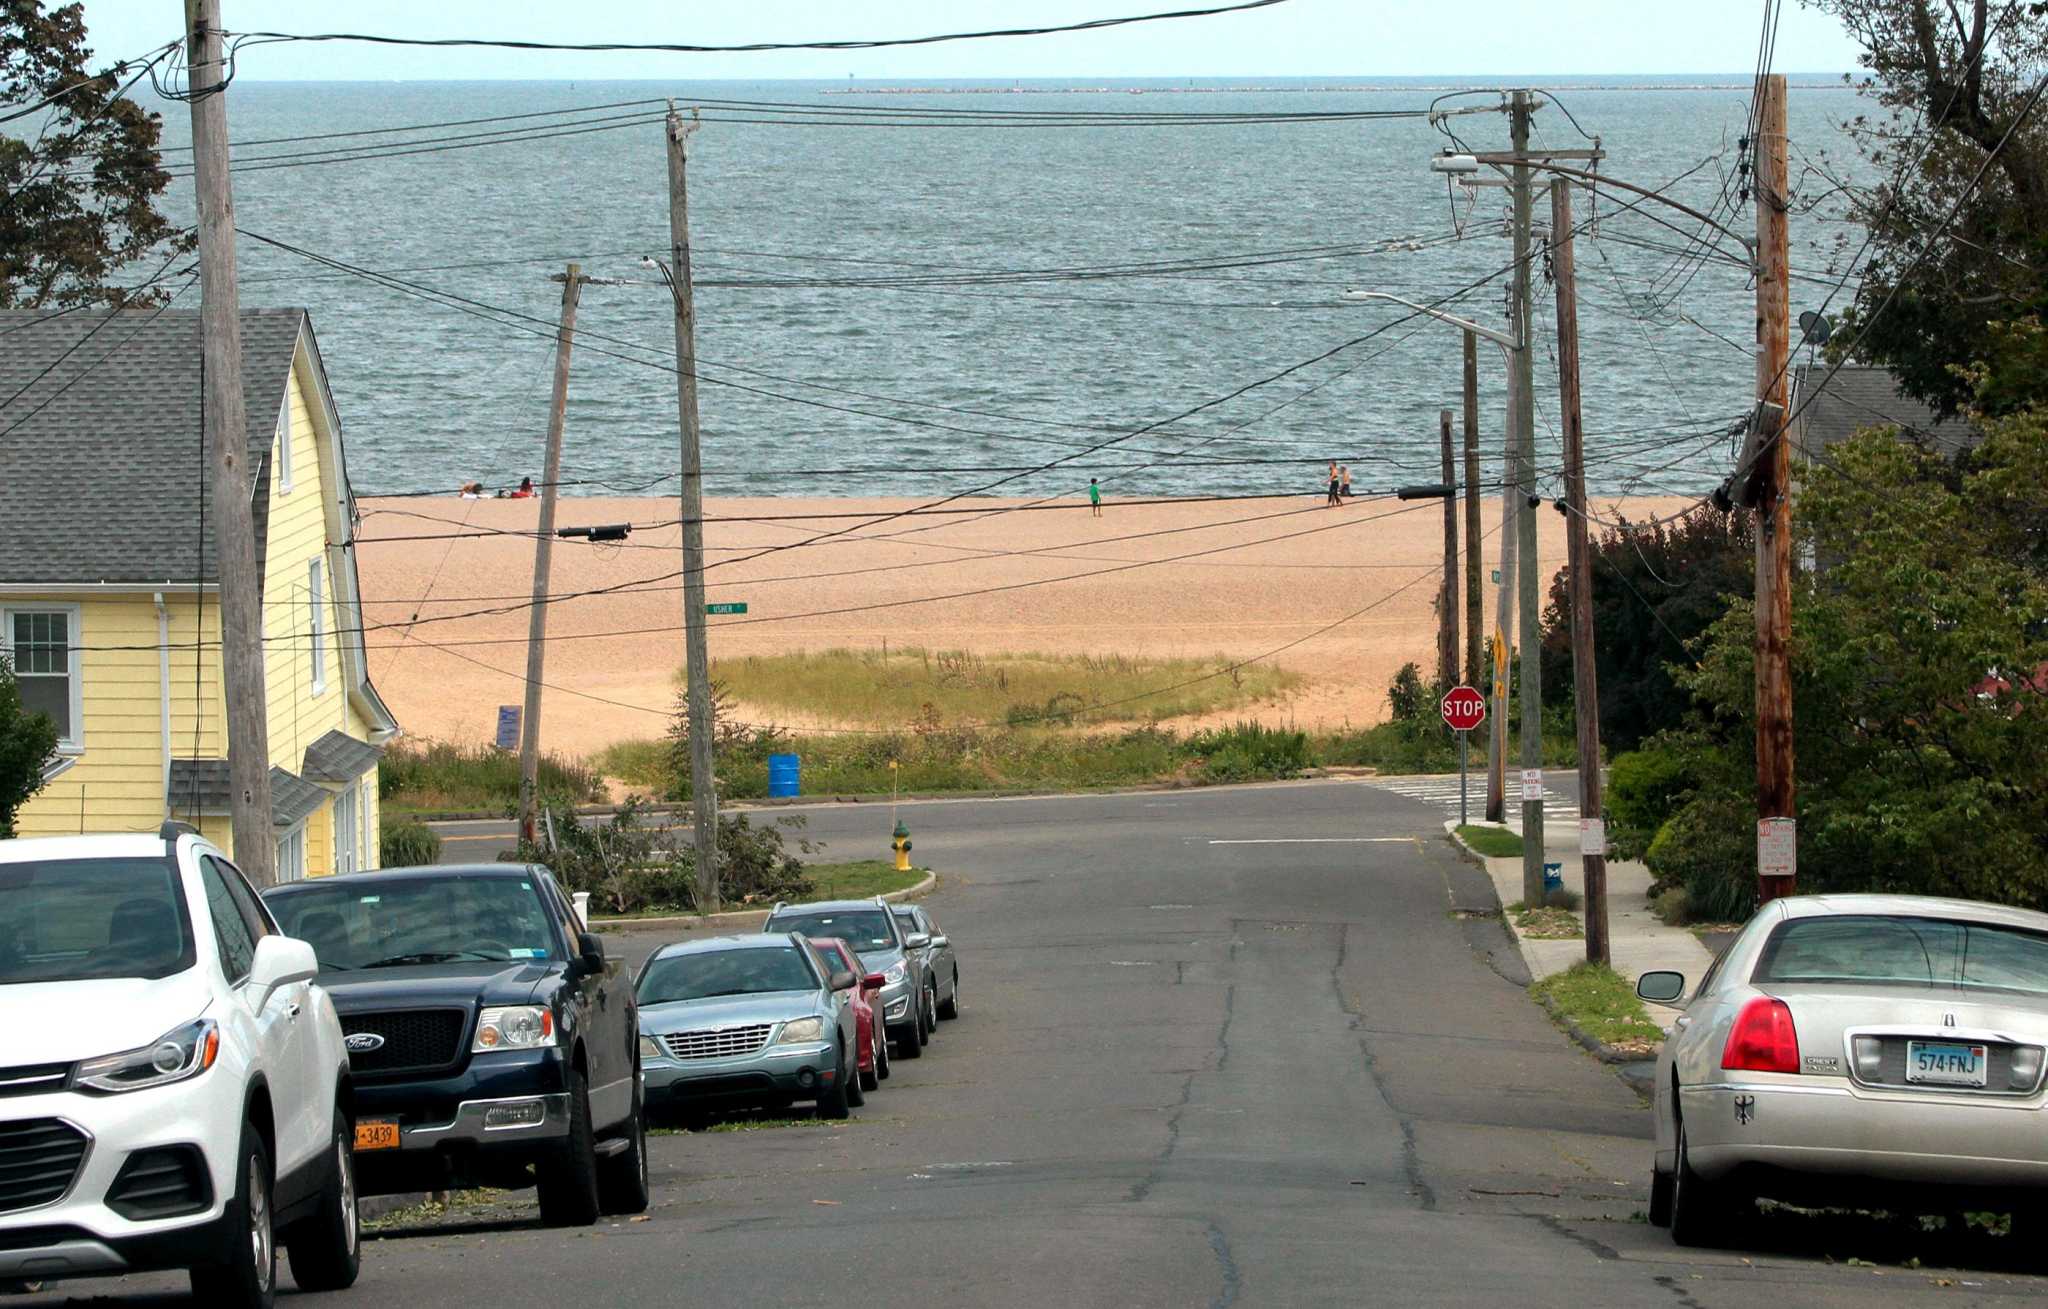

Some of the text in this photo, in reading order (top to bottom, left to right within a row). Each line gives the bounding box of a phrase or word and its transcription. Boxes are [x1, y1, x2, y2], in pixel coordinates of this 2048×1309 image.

[1443, 700, 1484, 717] STOP
[1759, 822, 1770, 834] NO
[347, 1036, 374, 1049] Ford
